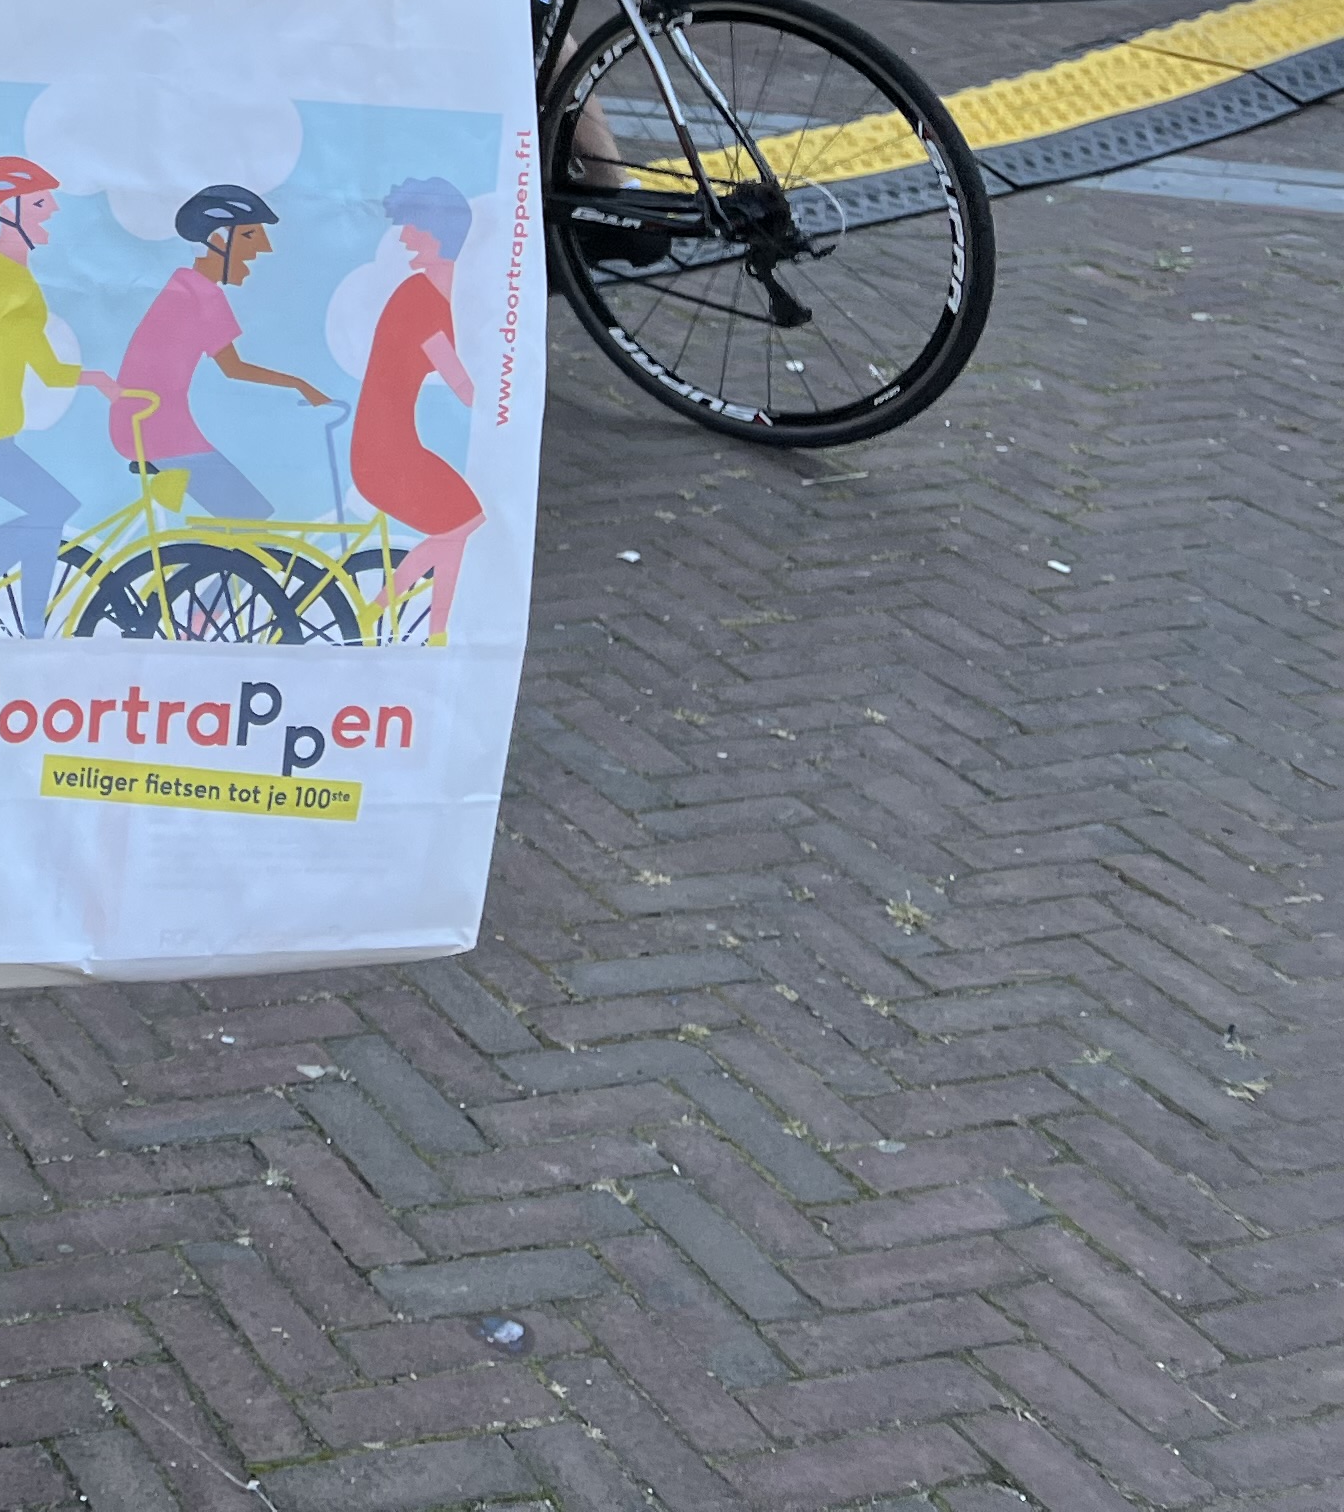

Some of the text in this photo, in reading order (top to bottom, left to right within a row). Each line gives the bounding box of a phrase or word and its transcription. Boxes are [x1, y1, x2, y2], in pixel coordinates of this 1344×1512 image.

[496, 129, 533, 427] www.doortrappen.frl
[53, 767, 139, 796] veiliger
[145, 773, 221, 801] fietsen
[228, 782, 260, 805] tot
[267, 785, 288, 811] je
